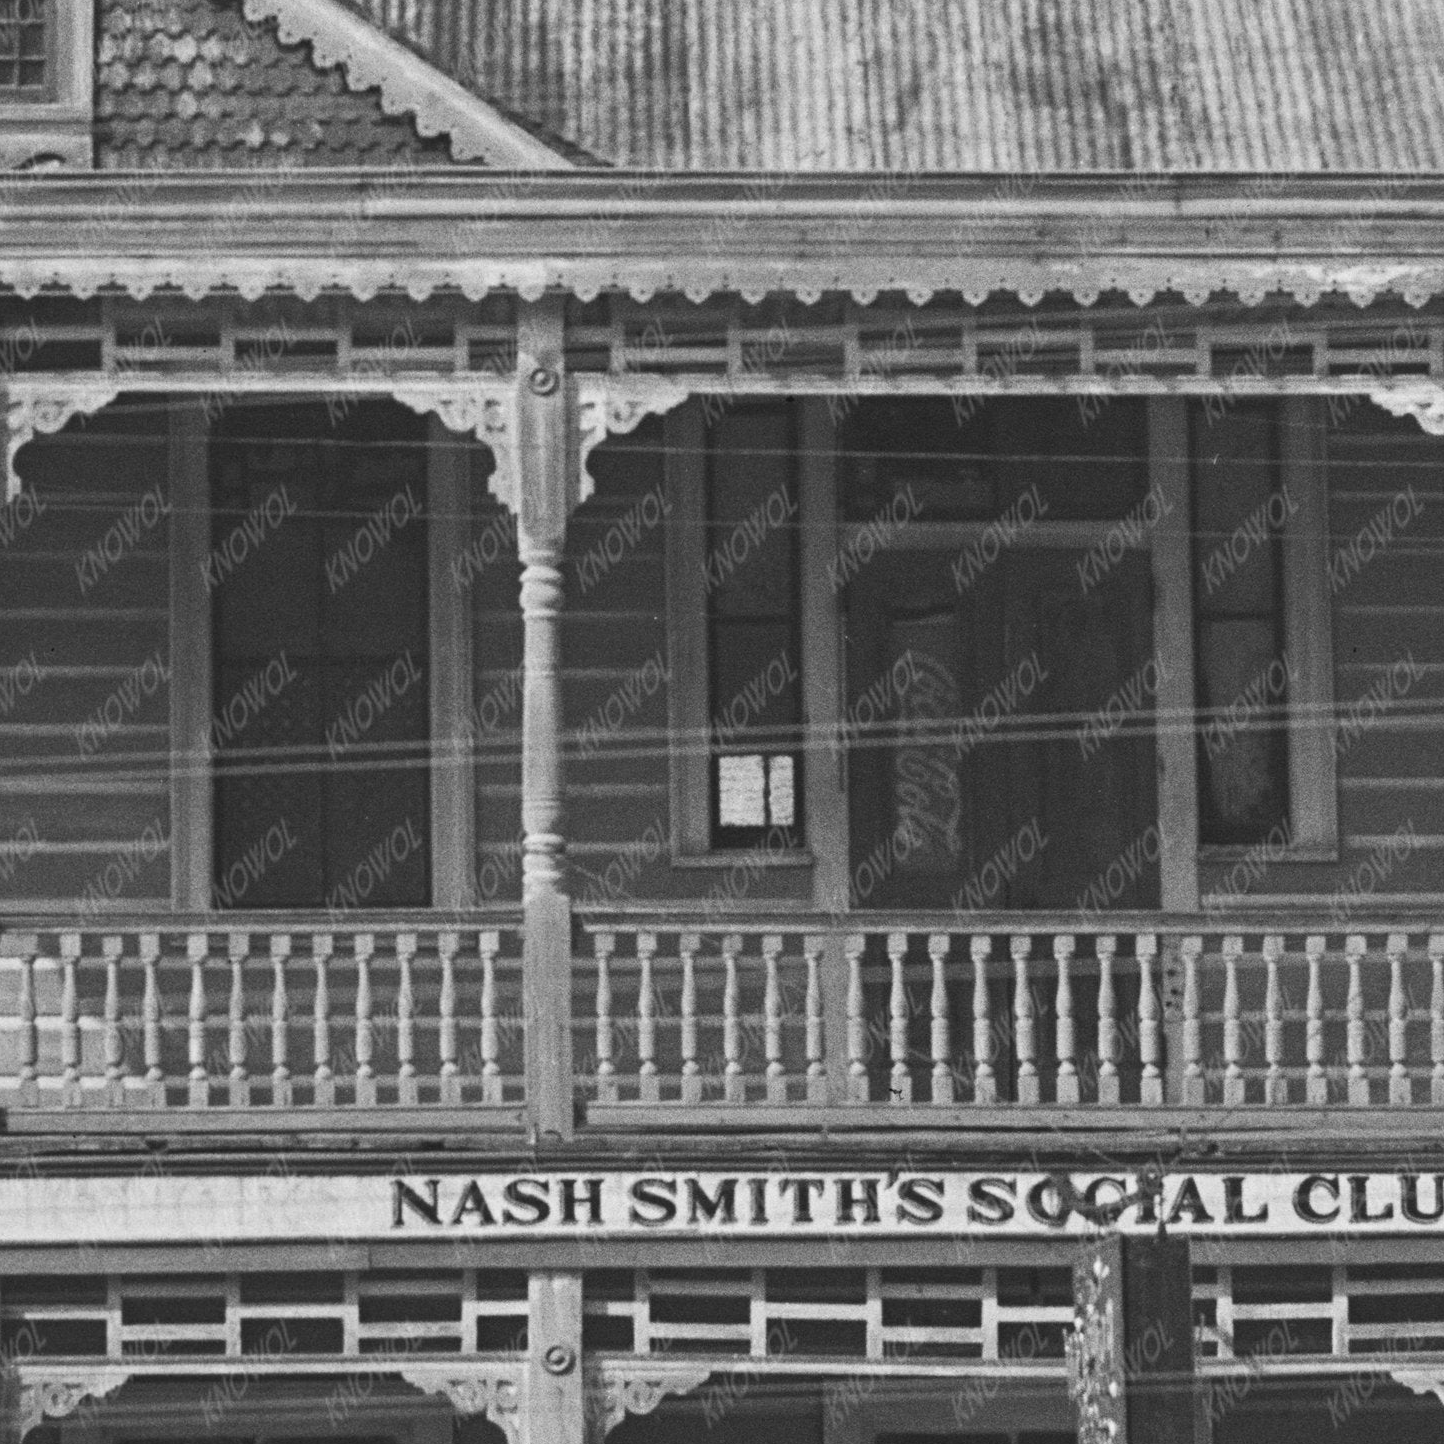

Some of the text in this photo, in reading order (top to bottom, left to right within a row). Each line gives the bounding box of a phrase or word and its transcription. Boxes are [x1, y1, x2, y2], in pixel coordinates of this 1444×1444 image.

[388, 1177, 605, 1230] NASH
[627, 1175, 945, 1228] SMITH'S
[967, 1175, 1270, 1228] SOCIAL
